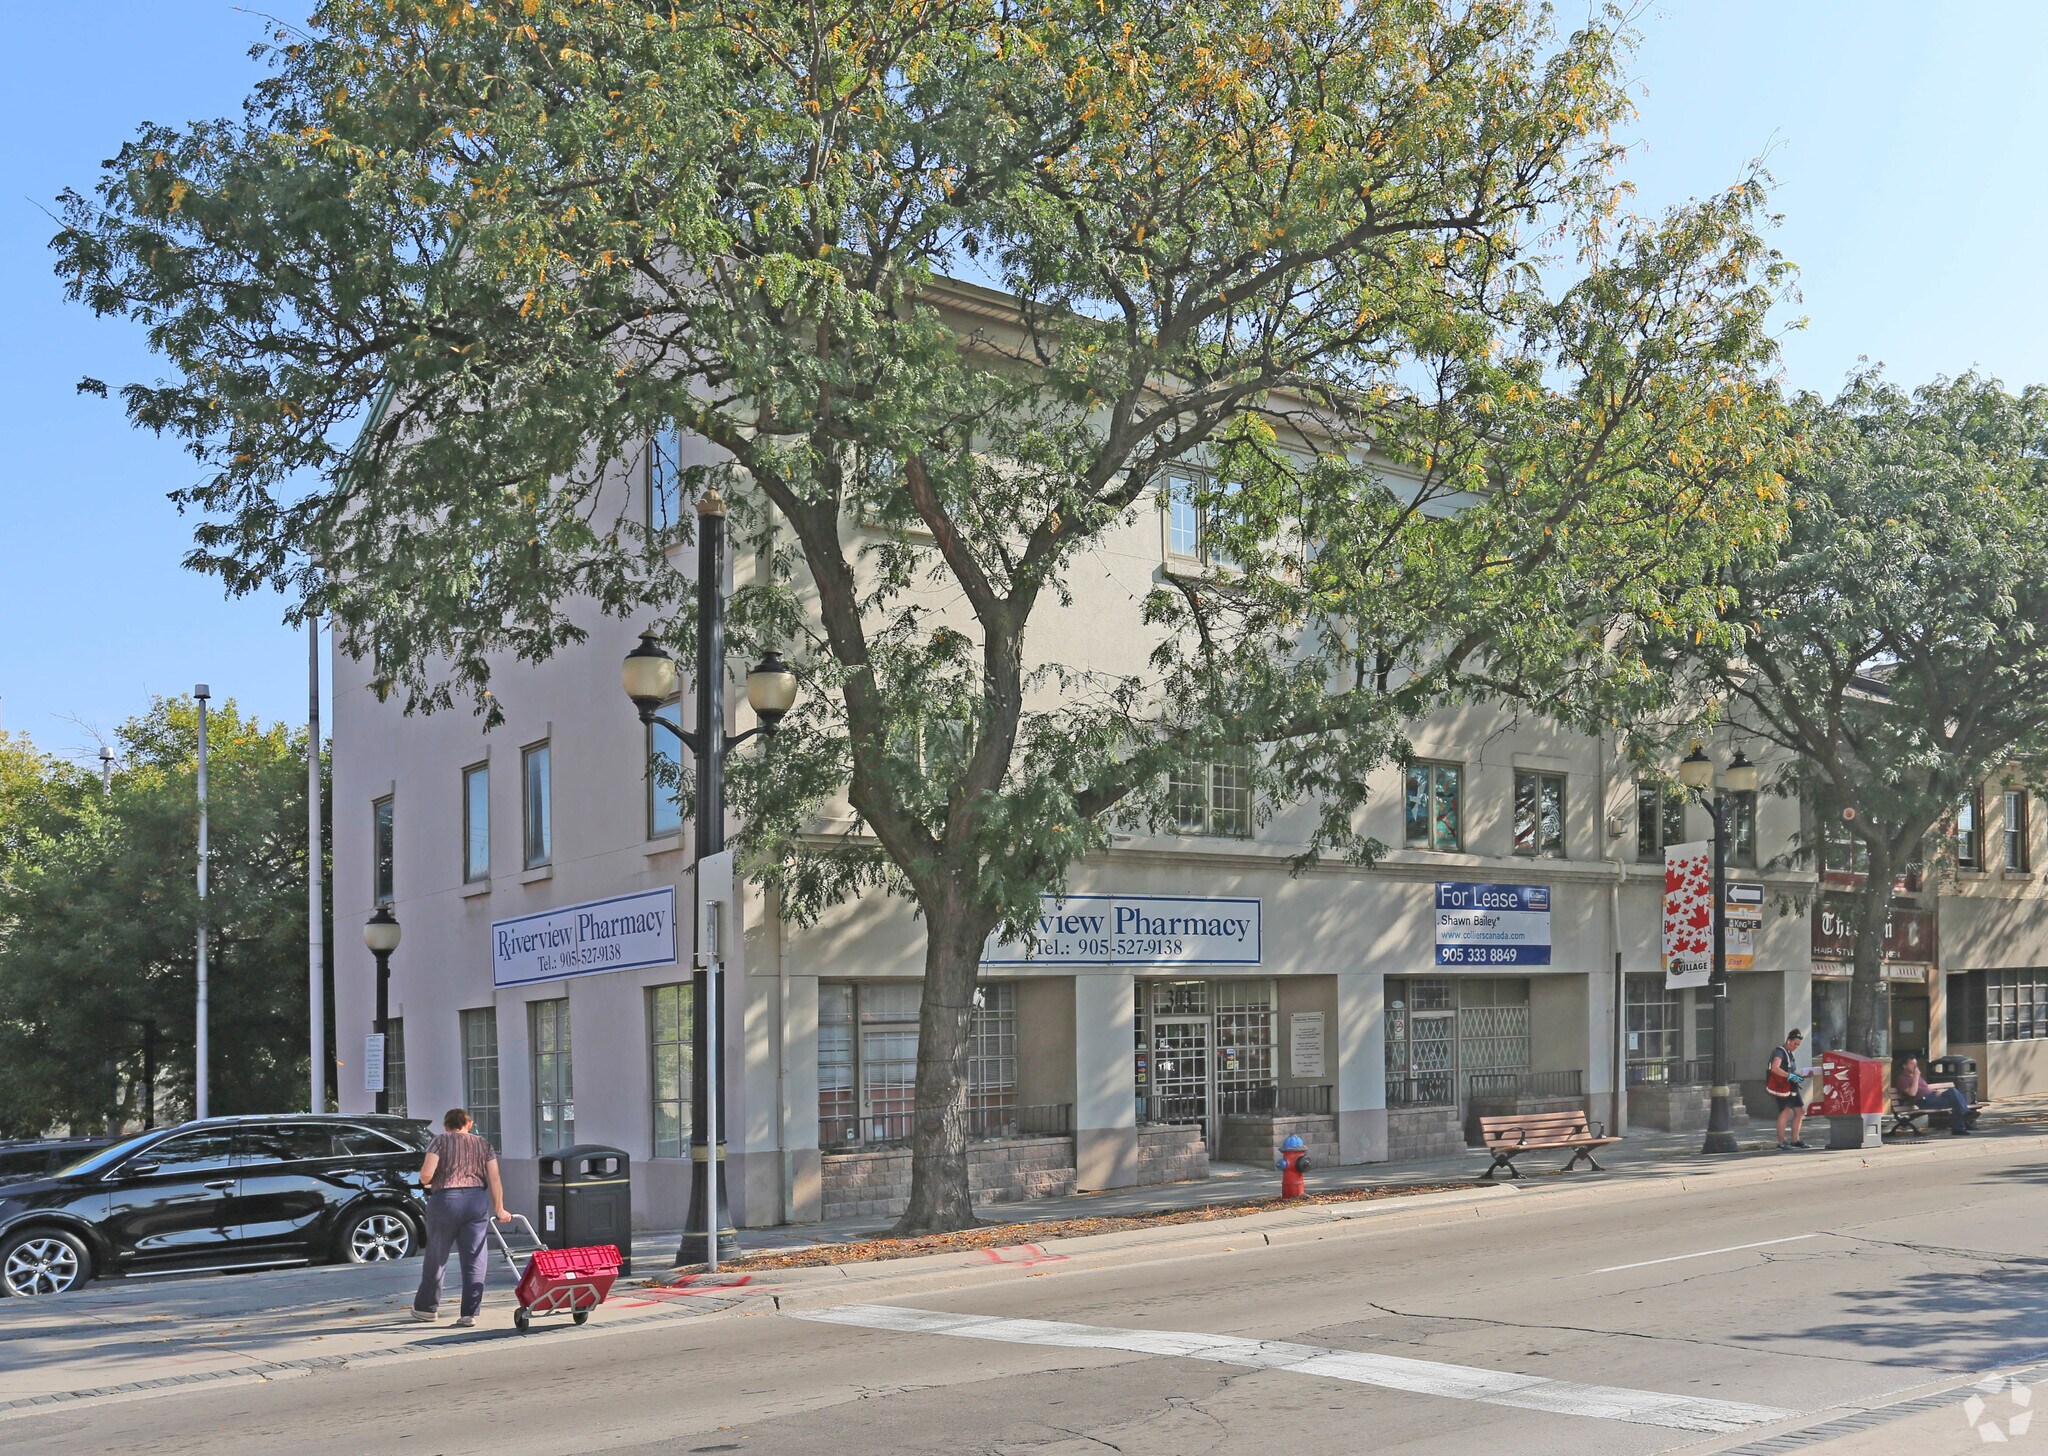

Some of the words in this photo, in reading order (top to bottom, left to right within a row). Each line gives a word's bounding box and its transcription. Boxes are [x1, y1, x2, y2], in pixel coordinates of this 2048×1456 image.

[1441, 885, 1468, 906] For
[1473, 886, 1518, 907] Lease
[578, 909, 665, 943] Pharmacy
[1114, 906, 1251, 942] Pharmacy
[1441, 914, 1471, 926] Shawn
[1752, 920, 1757, 928] E
[1441, 931, 1525, 940] www.collierscanada.com
[1035, 939, 1070, 955] Tel.:
[1078, 939, 1182, 955] 905-527-9138
[1442, 948, 1464, 962] 905
[1467, 948, 1486, 962] 333
[1490, 948, 1517, 962] 8849
[537, 956, 557, 972] Tel.:
[560, 943, 621, 967] 905-527-9138
[1679, 962, 1708, 971] VILLAGE
[1166, 989, 1191, 1009] 303
